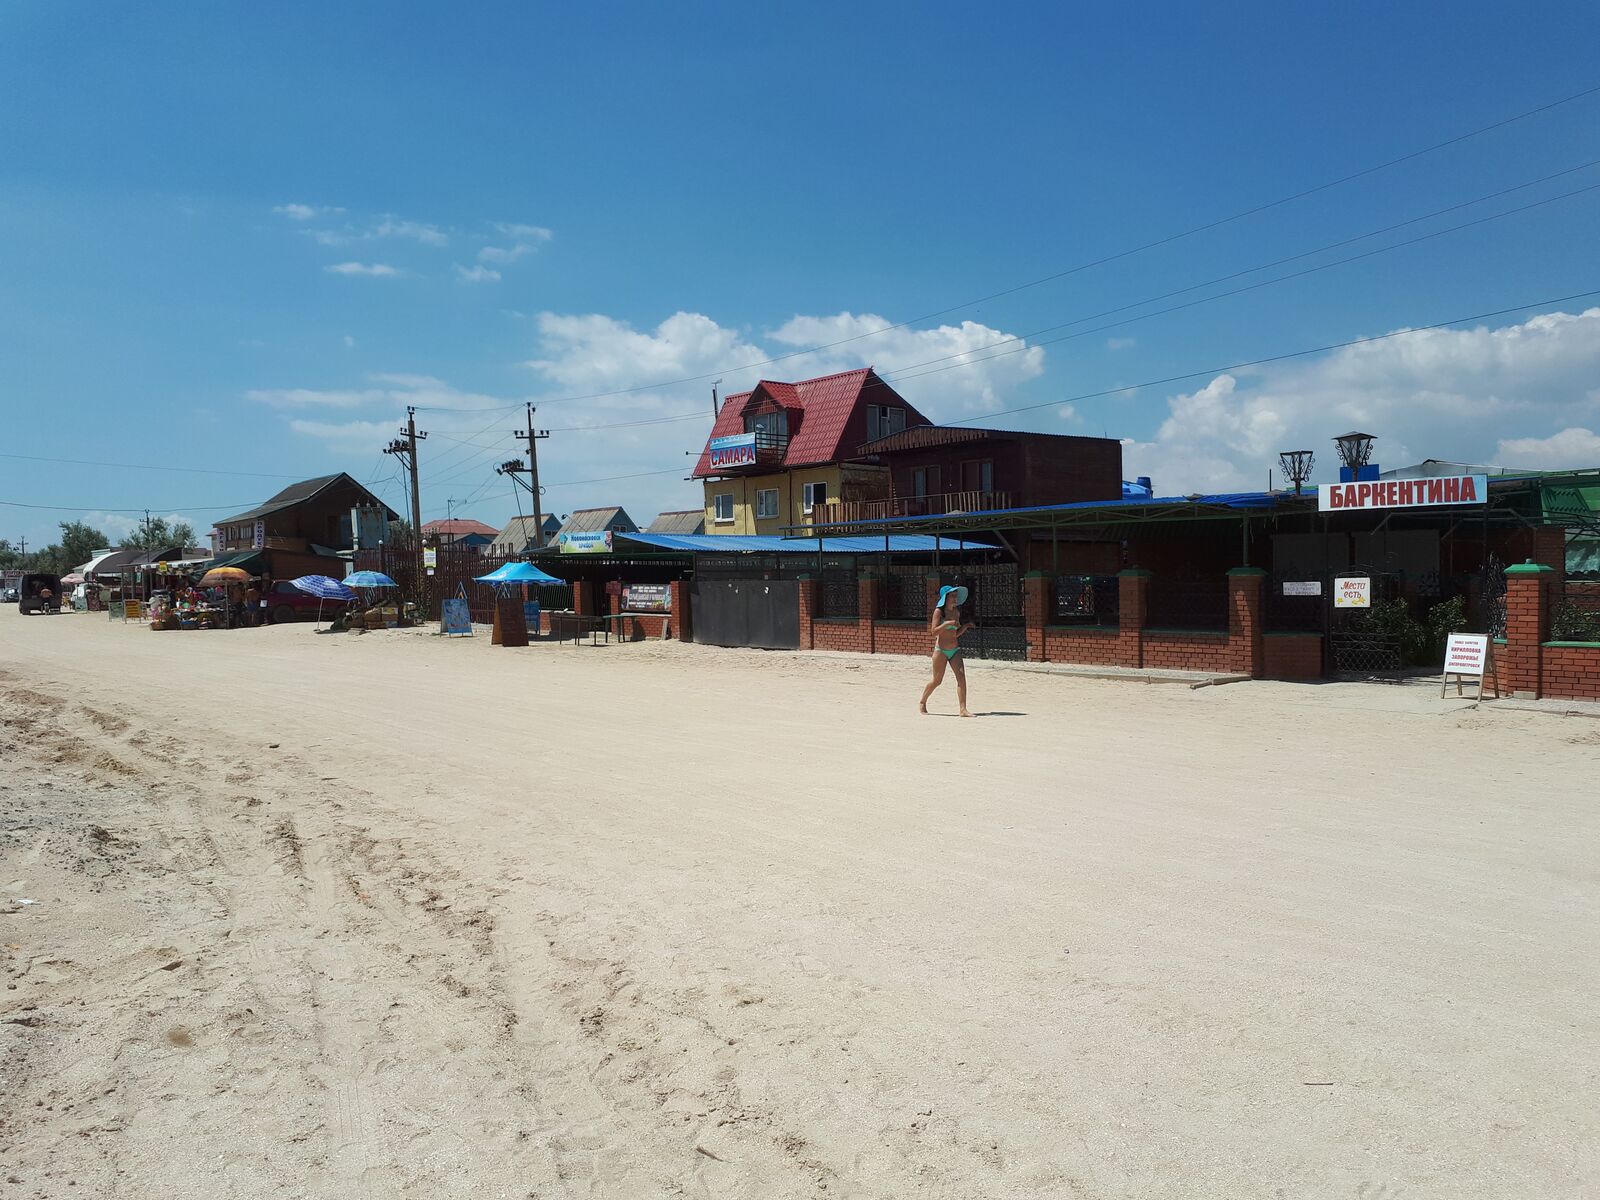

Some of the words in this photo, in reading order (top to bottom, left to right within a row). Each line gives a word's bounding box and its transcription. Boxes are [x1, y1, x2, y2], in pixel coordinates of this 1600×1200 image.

[711, 446, 754, 465] САМАРА
[1330, 477, 1476, 508] БАРКЕНТИНА
[1341, 581, 1366, 591] Места
[1343, 591, 1362, 599] есть
